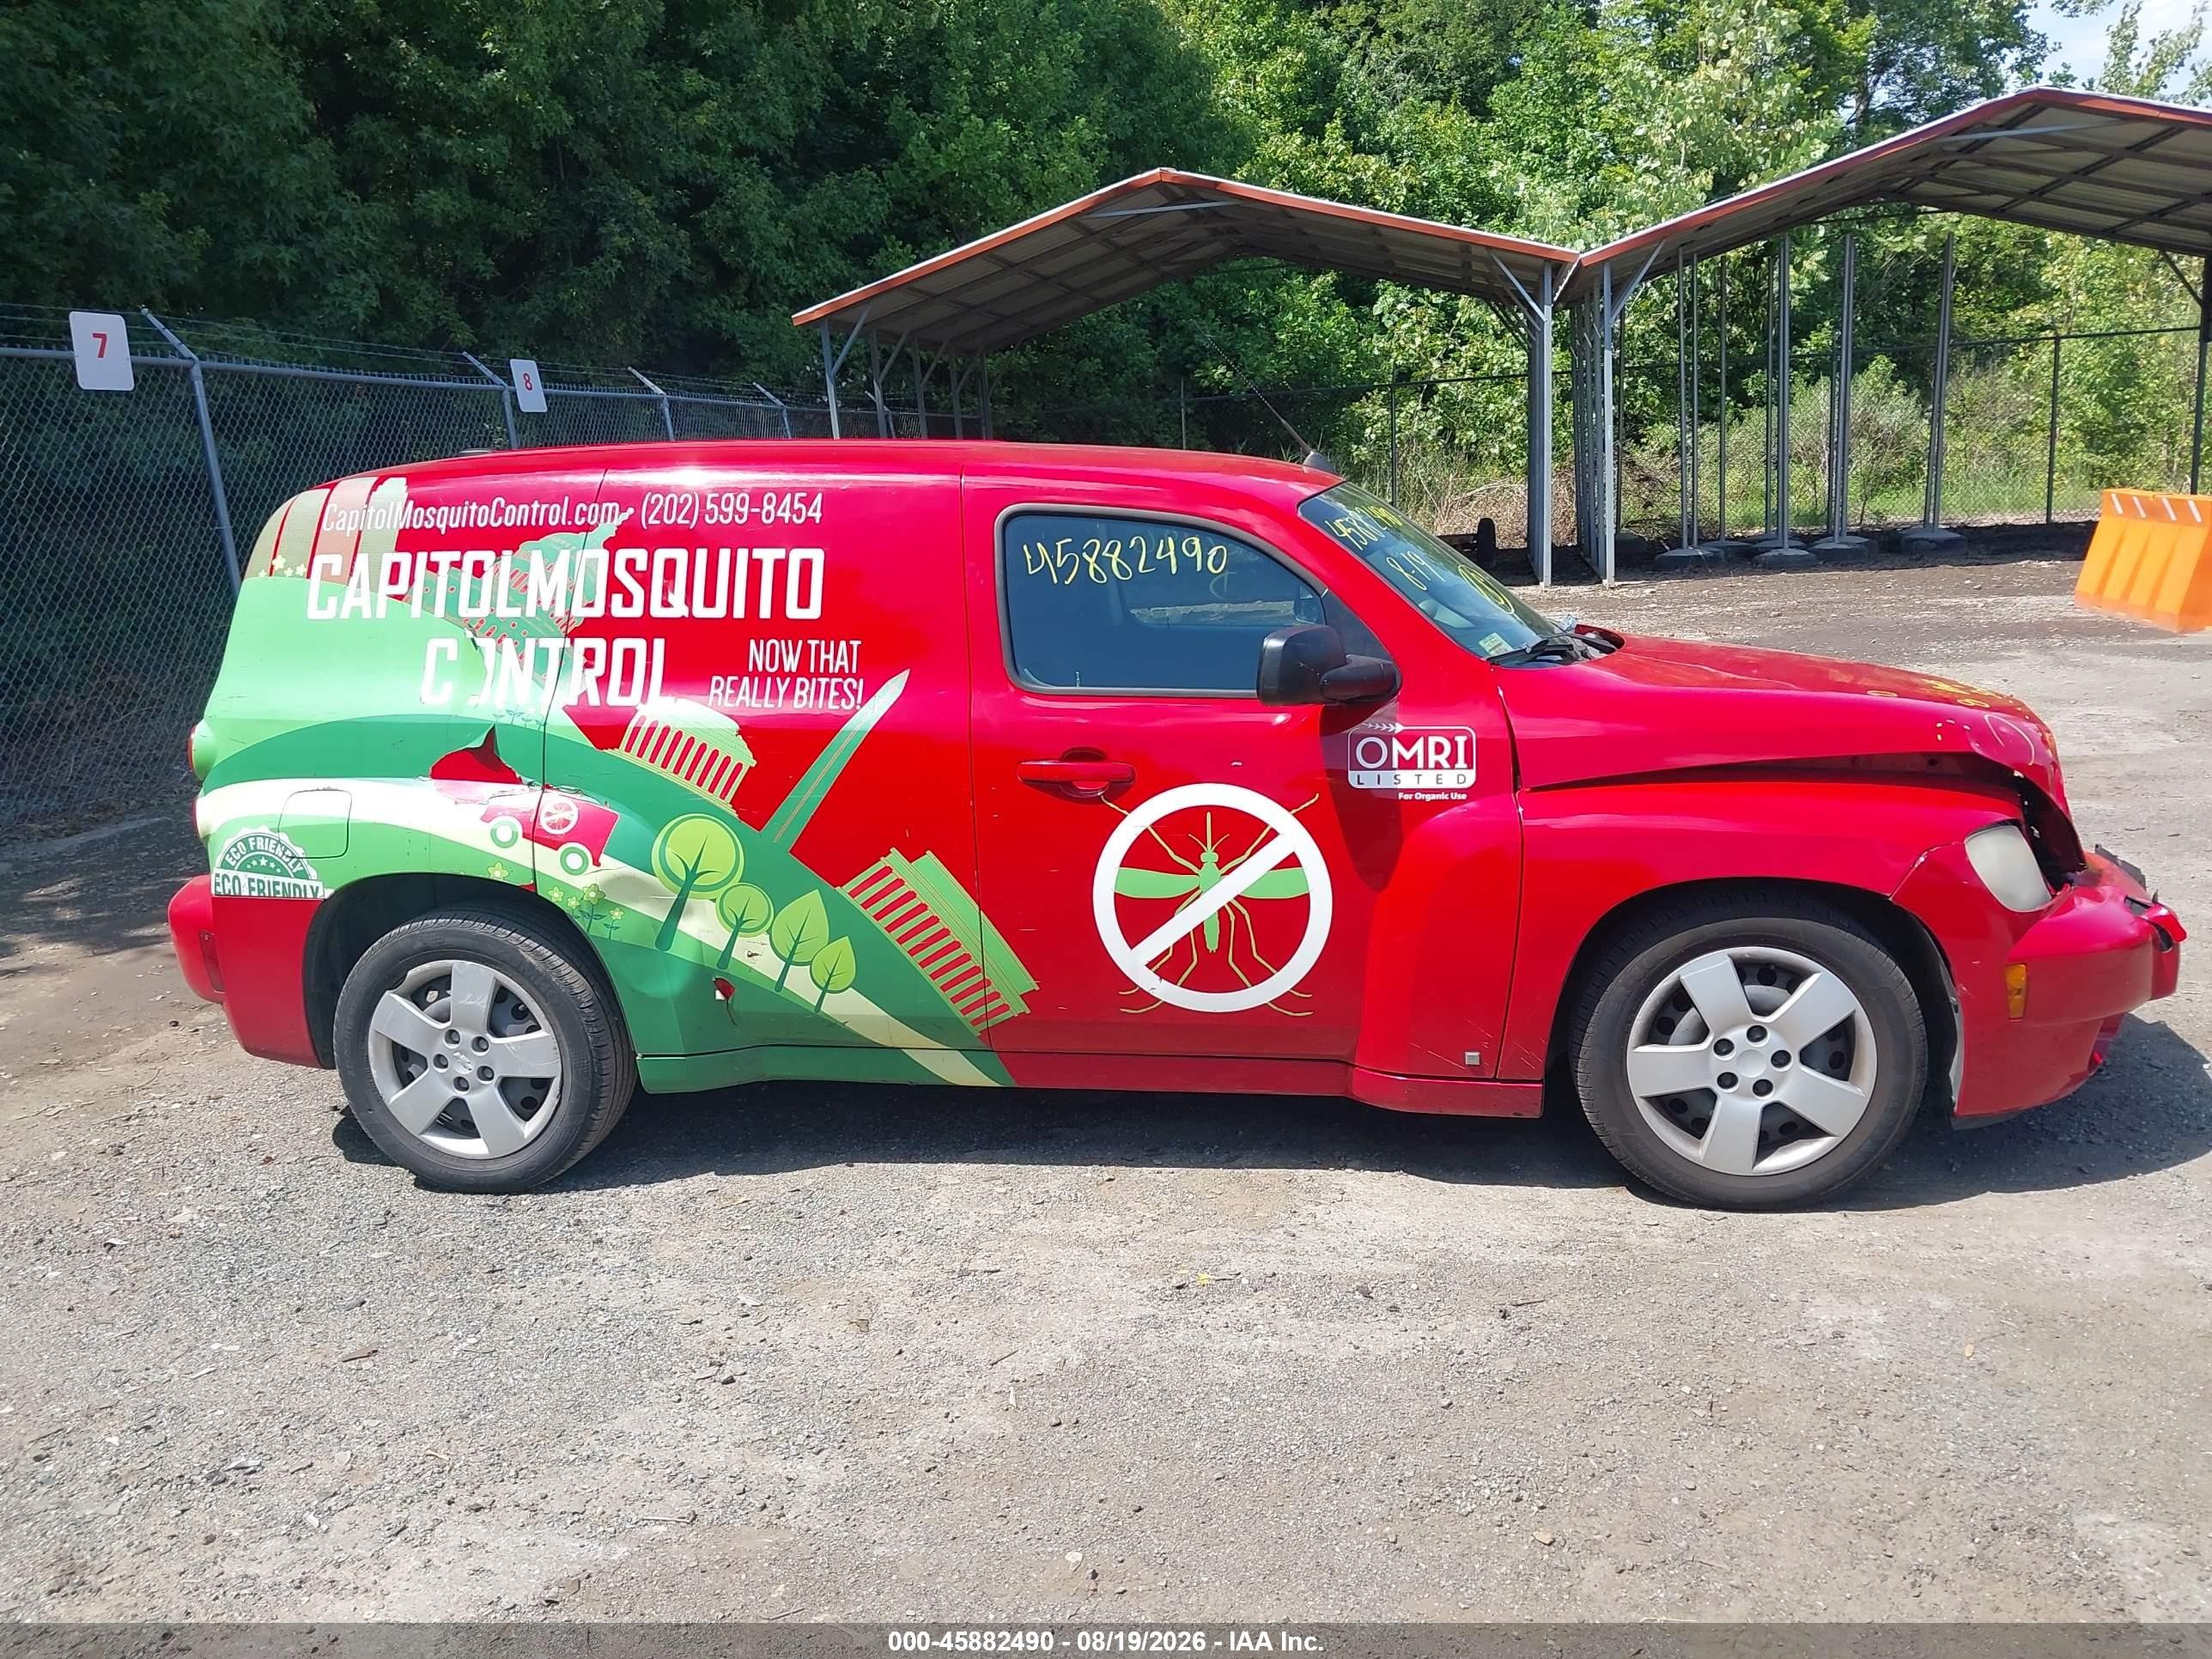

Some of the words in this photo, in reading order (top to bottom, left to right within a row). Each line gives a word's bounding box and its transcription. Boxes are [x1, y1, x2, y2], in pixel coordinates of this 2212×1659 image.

[91, 331, 108, 359] 7
[522, 372, 533, 392] 8
[321, 495, 620, 536] CapitolMosquitoControl.com
[641, 491, 700, 529] (202)
[704, 492, 823, 526] 599-8454
[1023, 535, 1228, 585] 45882490
[748, 638, 803, 673] NOW
[806, 639, 862, 674] THAT
[708, 675, 791, 708] REALLY
[793, 677, 864, 710] BITES!
[1355, 735, 1468, 769] OMRI
[1356, 773, 1468, 786] LISTED
[1398, 792, 1413, 800] For
[1413, 792, 1449, 802] Organic
[1450, 792, 1468, 800] Use
[224, 841, 247, 866] ECO
[247, 836, 304, 873] FRIENDLY
[214, 872, 242, 896] ECO
[247, 877, 320, 898] FRIENDLY
